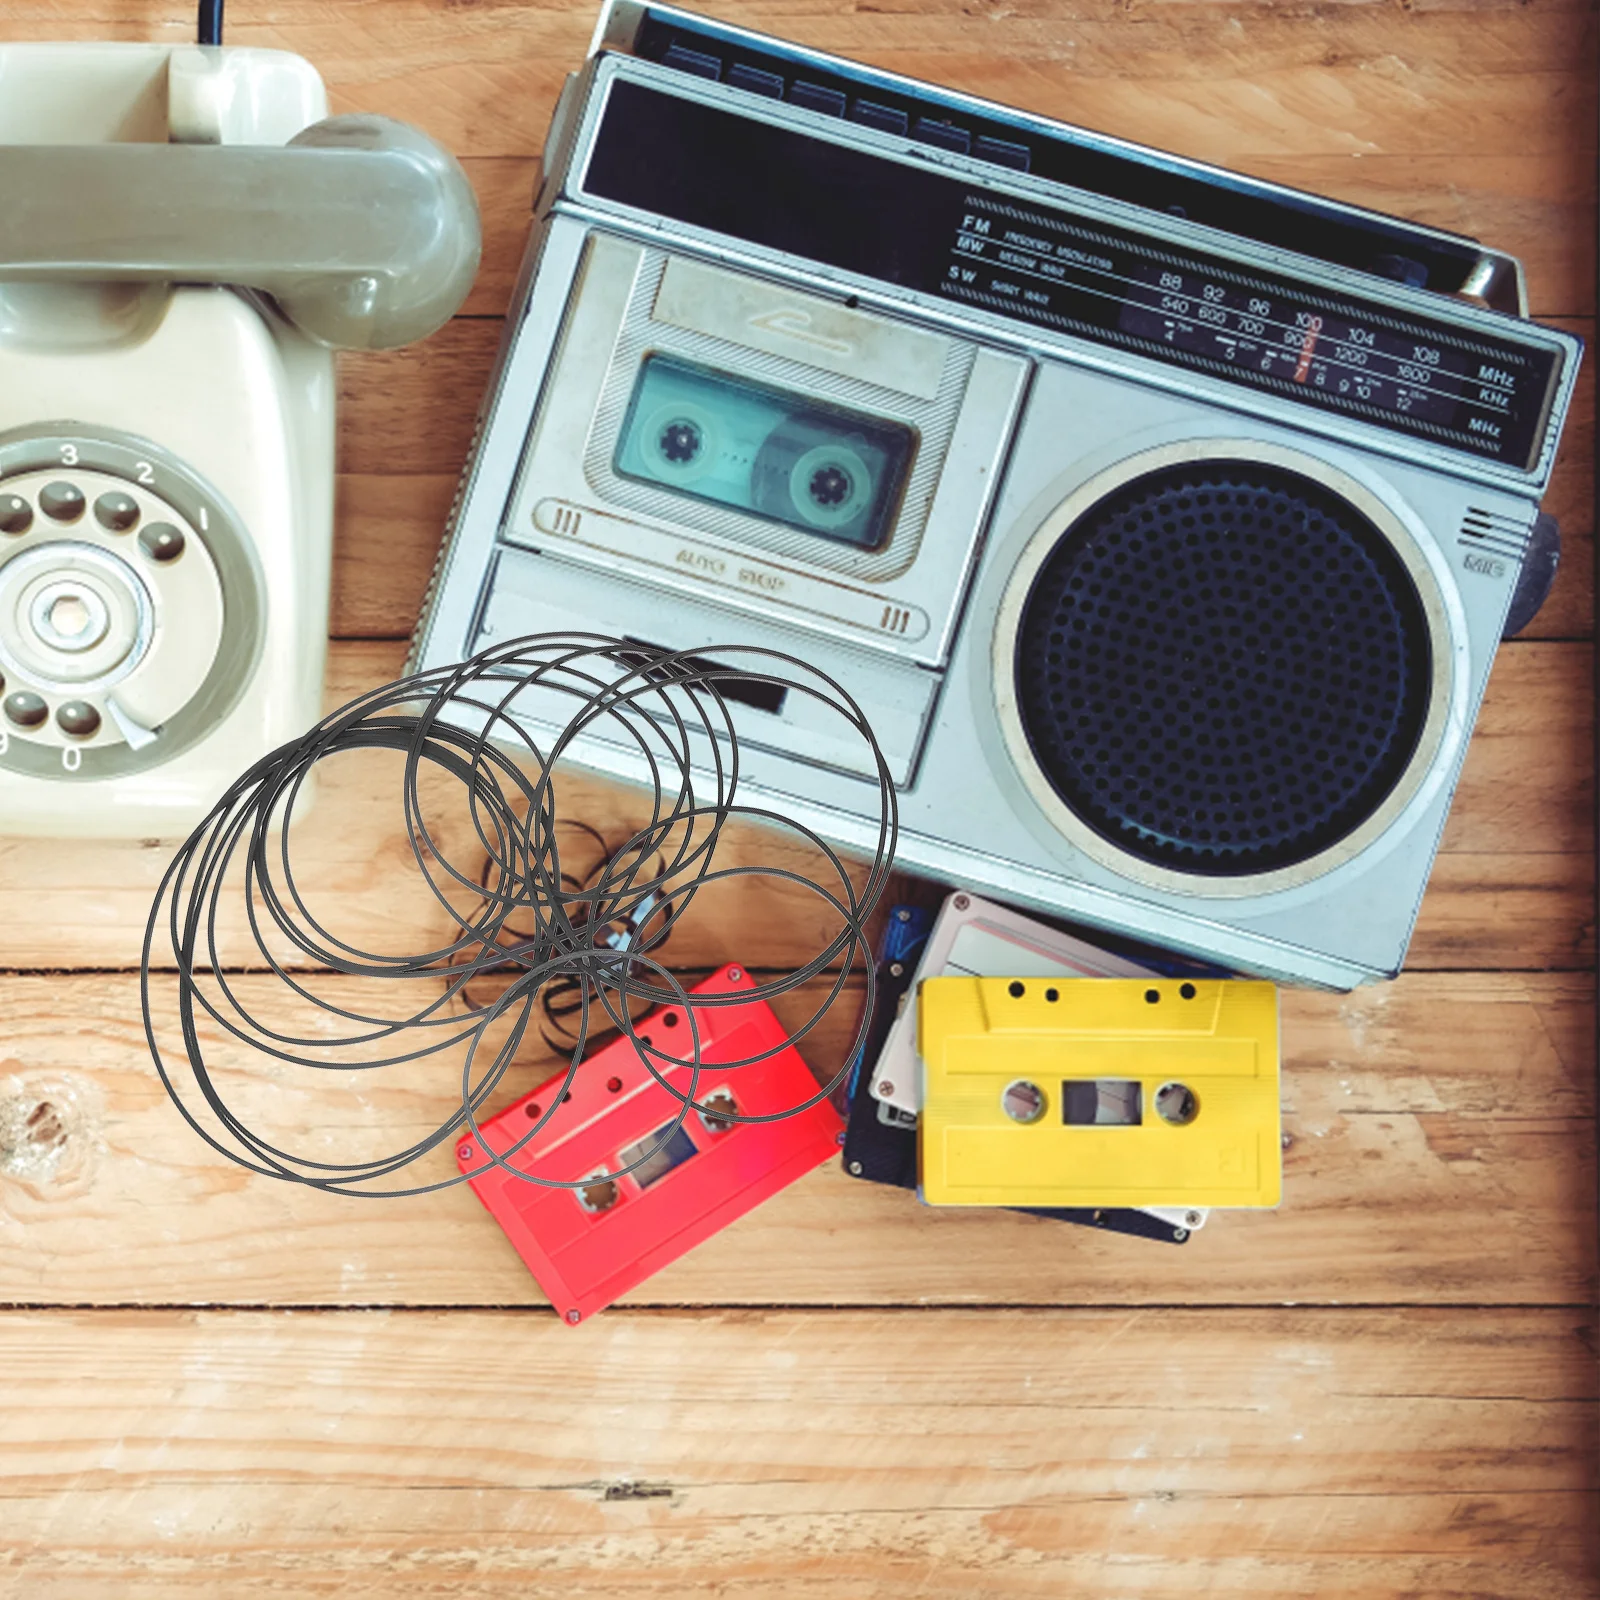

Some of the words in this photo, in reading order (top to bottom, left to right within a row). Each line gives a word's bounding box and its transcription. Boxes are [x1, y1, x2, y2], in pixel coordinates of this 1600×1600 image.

[949, 266, 977, 283] SW
[957, 235, 984, 253] MW
[1161, 296, 1189, 313] 540
[1198, 306, 1226, 324] 600
[1238, 317, 1264, 335] 700
[1284, 331, 1312, 349] 900
[1335, 346, 1368, 365] 1200
[962, 215, 991, 234] FM
[1160, 273, 1182, 290] 88
[1203, 285, 1225, 303] 92
[1248, 299, 1271, 316] 96
[1296, 312, 1322, 332] 100
[1349, 328, 1376, 346] 104
[1413, 346, 1440, 365] 108
[1478, 365, 1516, 388] MHz
[1164, 330, 1174, 342] 4
[1225, 347, 1235, 360] 5
[1261, 357, 1271, 370] 6
[1314, 373, 1326, 386] 8
[1339, 379, 1350, 393] 9
[1356, 385, 1371, 399] 10
[1397, 397, 1412, 411] 12
[1469, 418, 1502, 438] MHz
[61, 444, 78, 465] 3
[136, 462, 155, 484] 2
[200, 507, 208, 531] 1
[62, 747, 81, 771] 0
